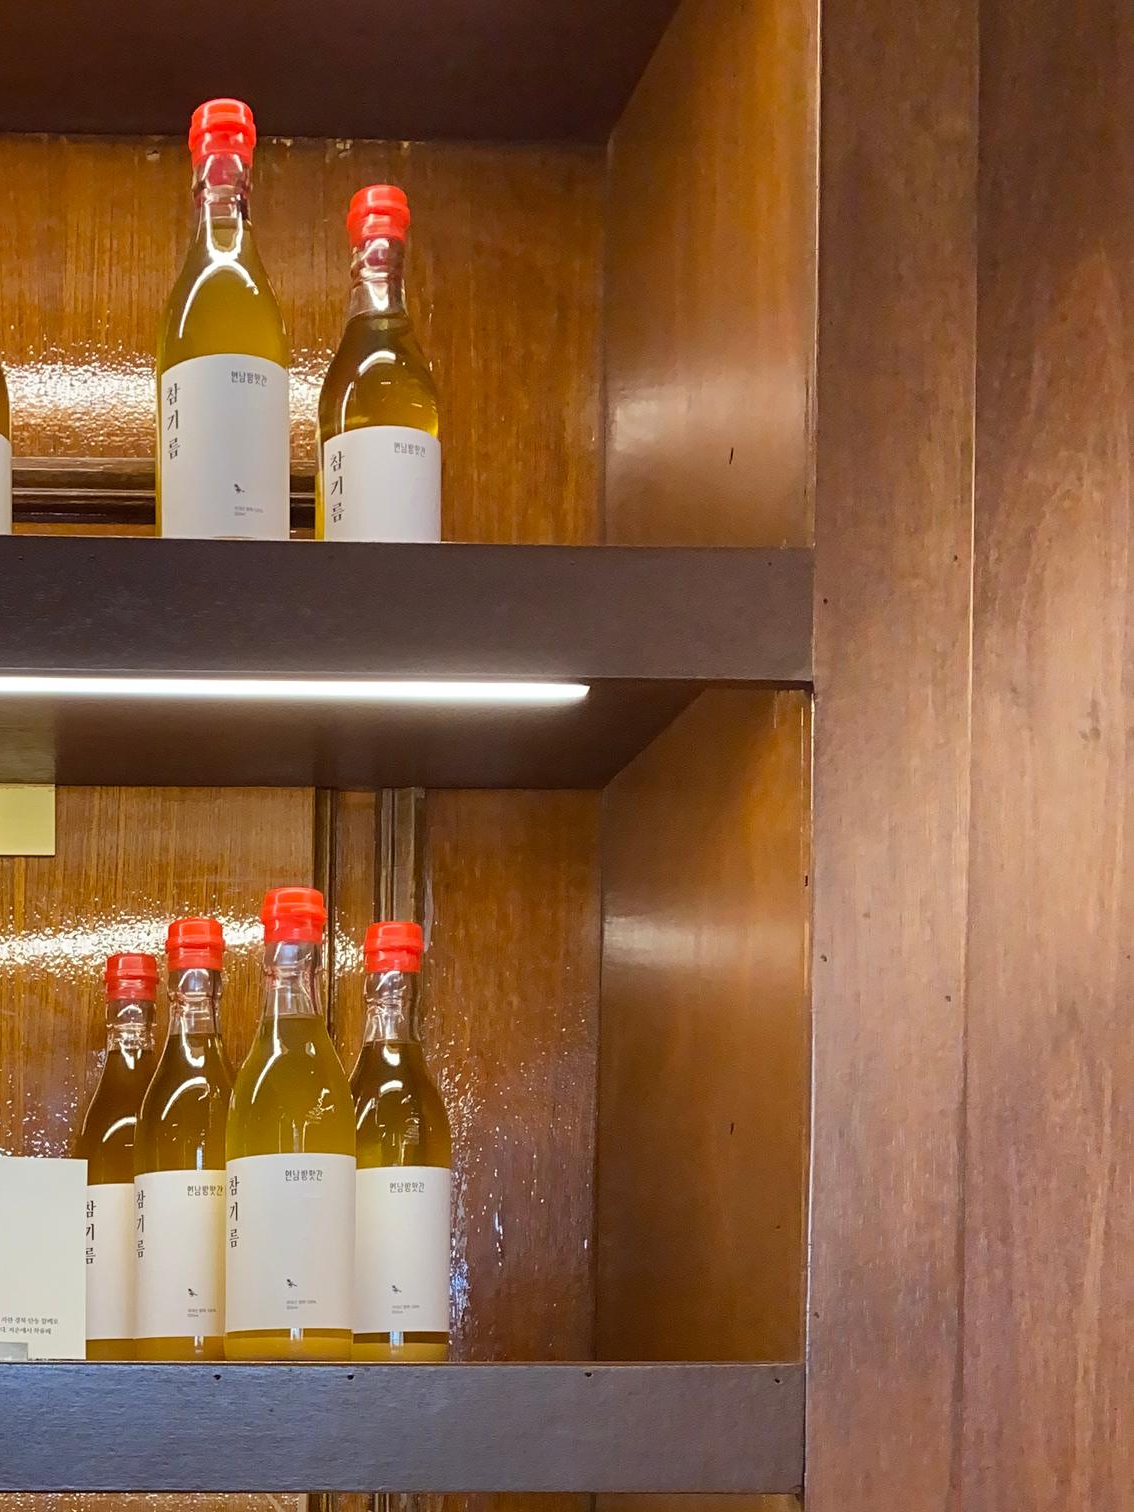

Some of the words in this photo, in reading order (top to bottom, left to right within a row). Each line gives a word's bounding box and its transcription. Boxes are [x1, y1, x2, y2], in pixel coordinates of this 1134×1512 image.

[166, 383, 180, 460] 참기름
[330, 451, 345, 523] 참기름
[187, 1185, 223, 1197] 연남방앗간
[285, 1169, 323, 1181] 연남방앗간
[86, 1200, 96, 1264] 참기름
[136, 1190, 146, 1258] 참기름
[229, 1176, 239, 1248] 참기름
